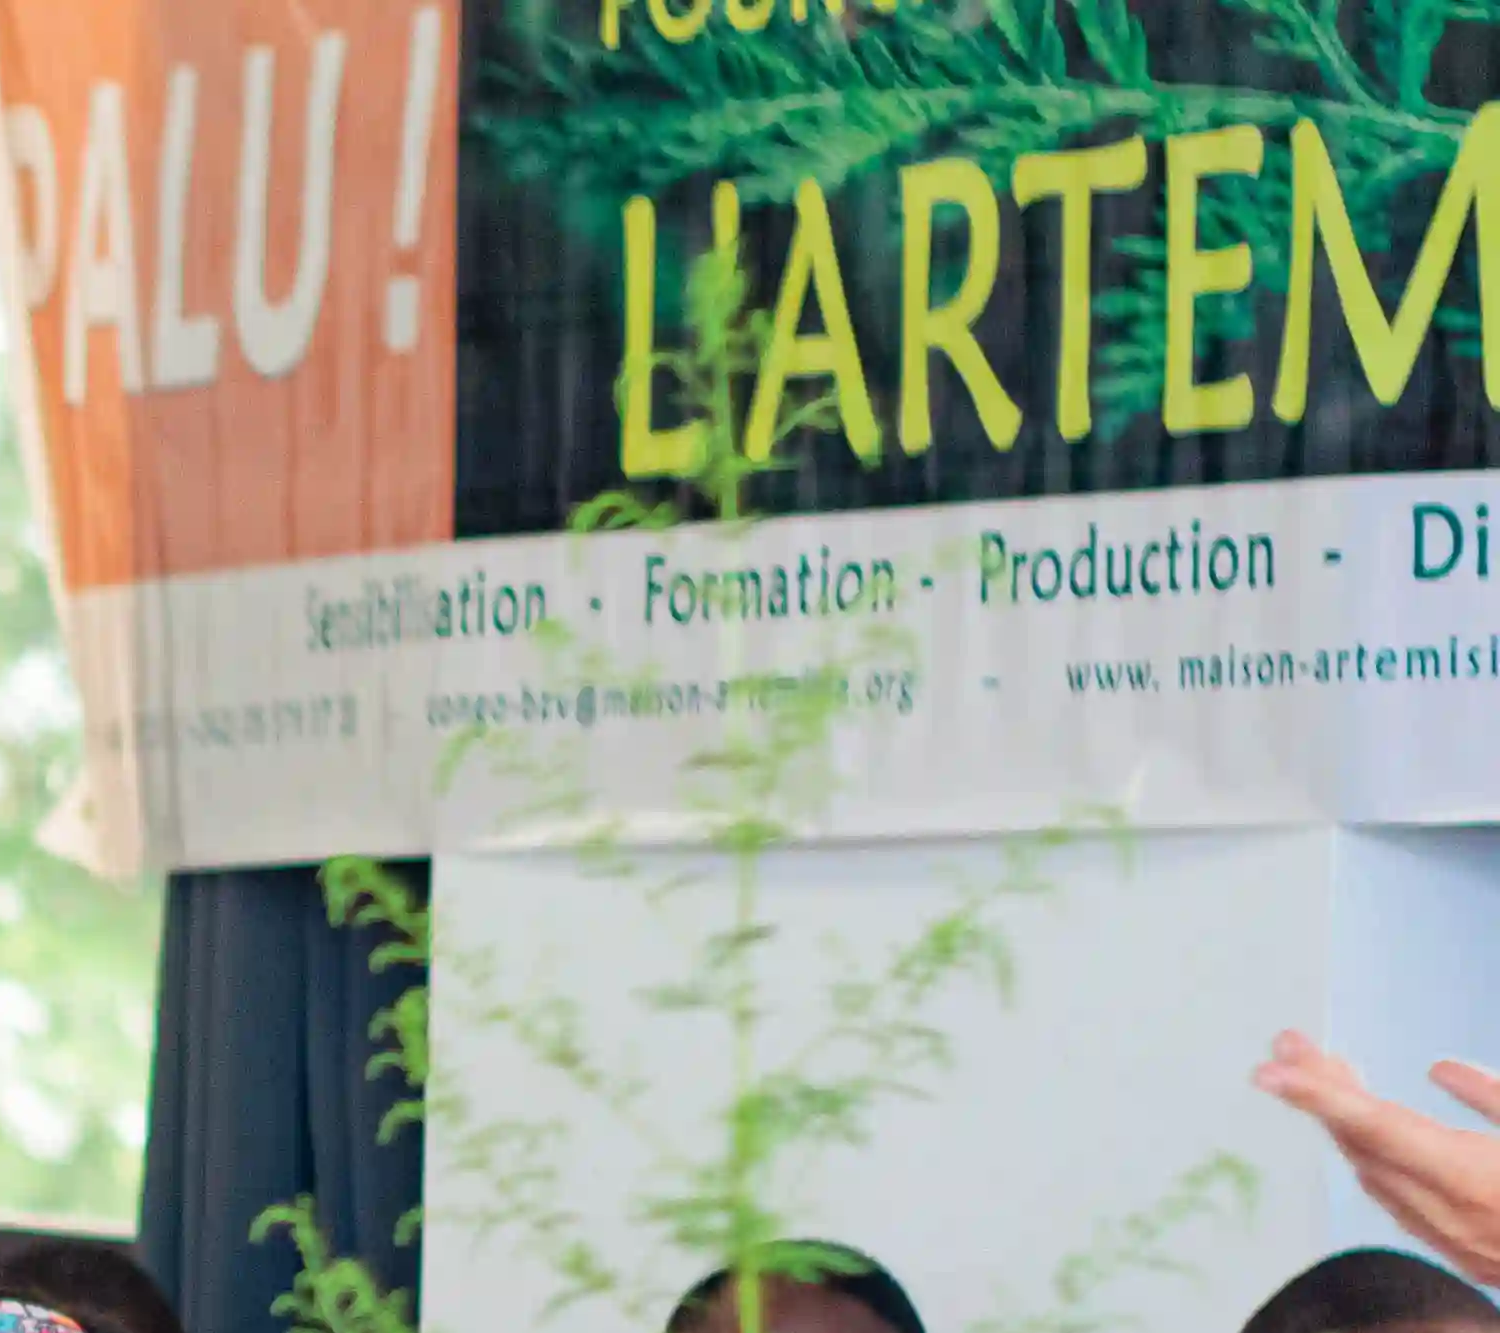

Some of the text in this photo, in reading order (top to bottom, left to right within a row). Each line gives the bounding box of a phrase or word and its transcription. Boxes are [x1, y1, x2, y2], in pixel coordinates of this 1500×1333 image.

[6, 33, 346, 408] PALU
[644, 543, 895, 625] Formation
[978, 519, 1276, 604] Production
[1411, 502, 1490, 581] Di
